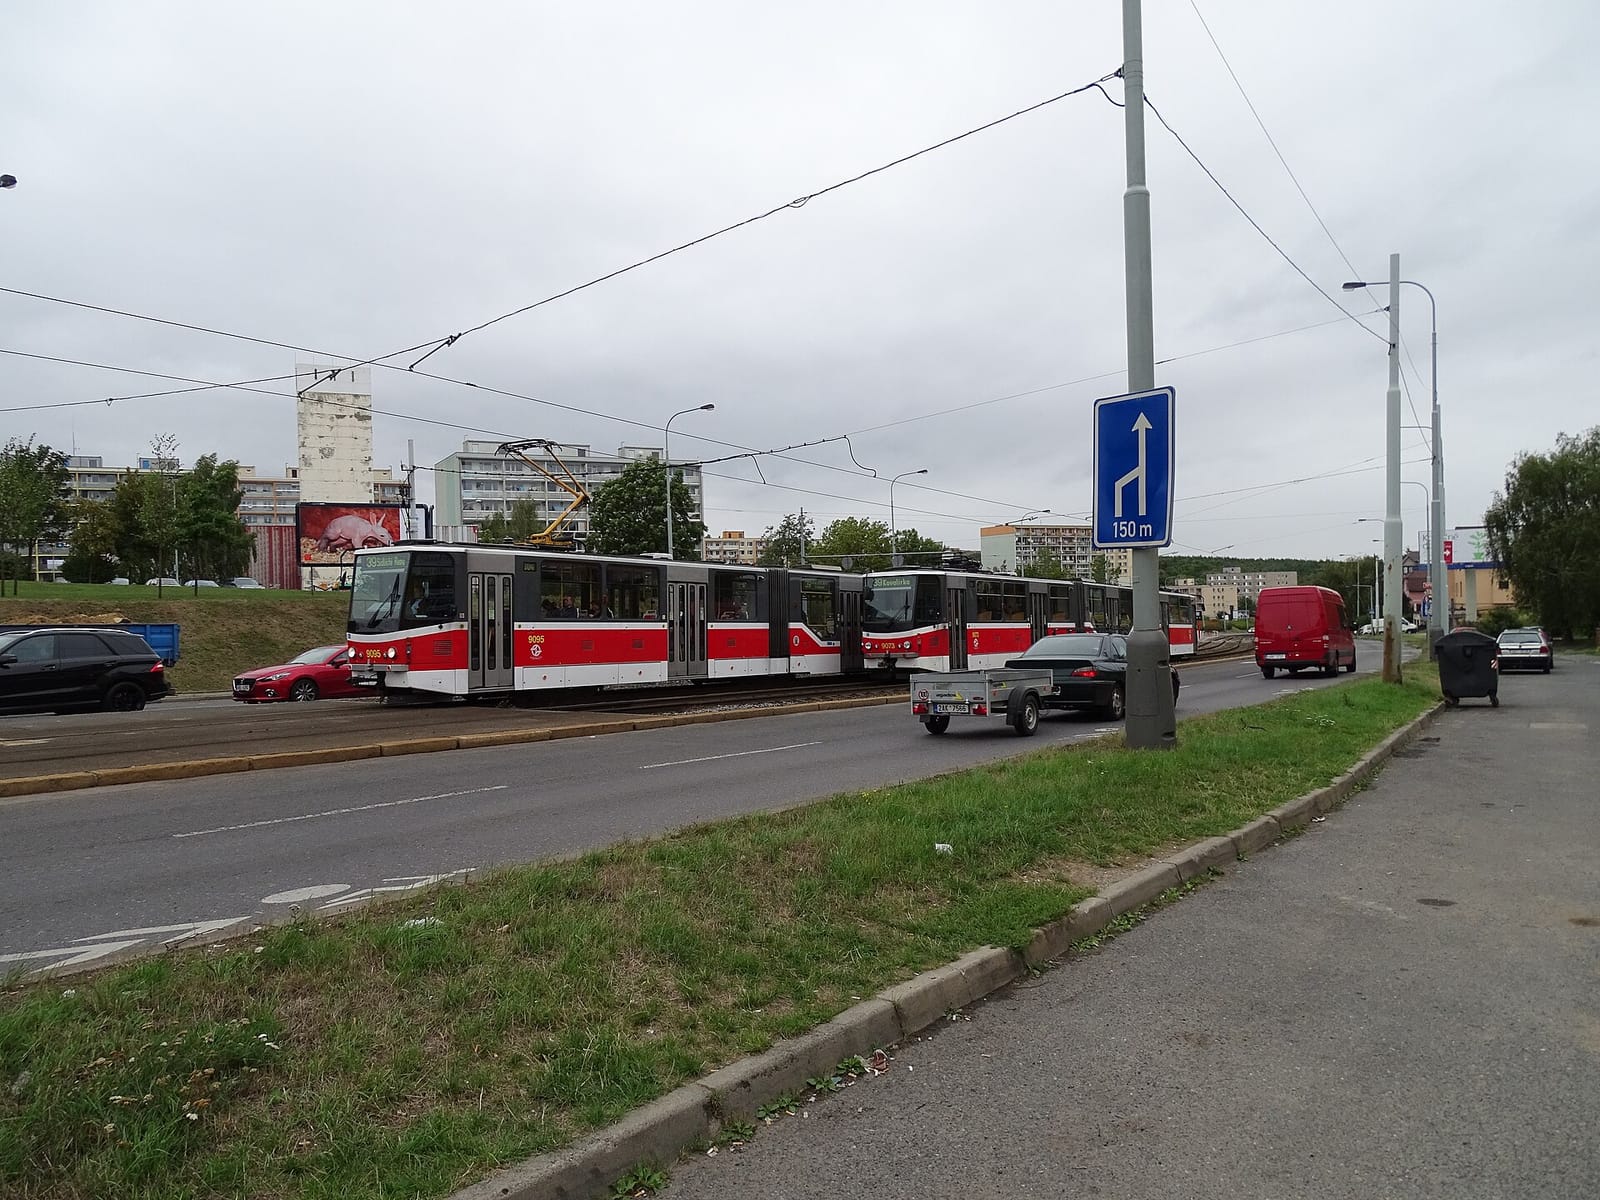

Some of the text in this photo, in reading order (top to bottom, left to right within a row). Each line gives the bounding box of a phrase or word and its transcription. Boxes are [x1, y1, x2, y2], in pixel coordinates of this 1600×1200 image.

[1112, 521, 1152, 538] 150 m
[528, 635, 545, 644] 9095
[366, 649, 381, 658] 9095
